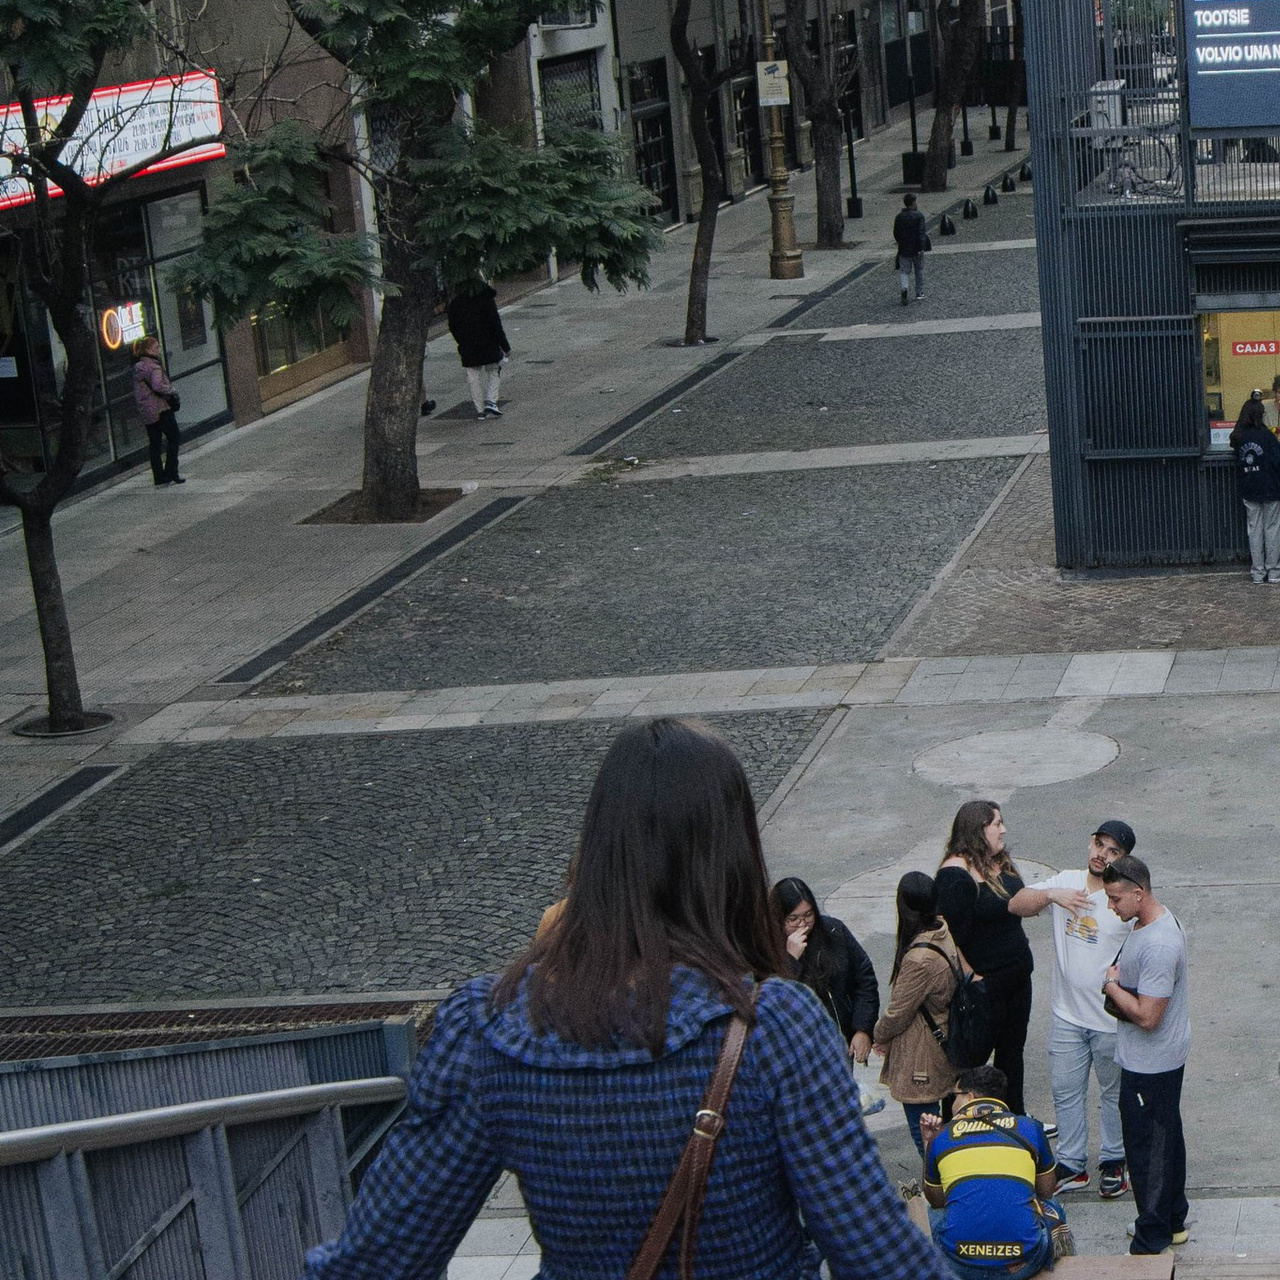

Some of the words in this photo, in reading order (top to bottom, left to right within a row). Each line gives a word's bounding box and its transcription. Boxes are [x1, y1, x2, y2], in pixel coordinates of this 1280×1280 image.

[1195, 8, 1250, 27] TOOTSIE
[1196, 46, 1242, 64] VOLVIO
[1244, 44, 1271, 62] UNA
[1236, 344, 1267, 353] CAJA
[1269, 343, 1276, 352] 3
[959, 1244, 1021, 1256] XENEIZES
